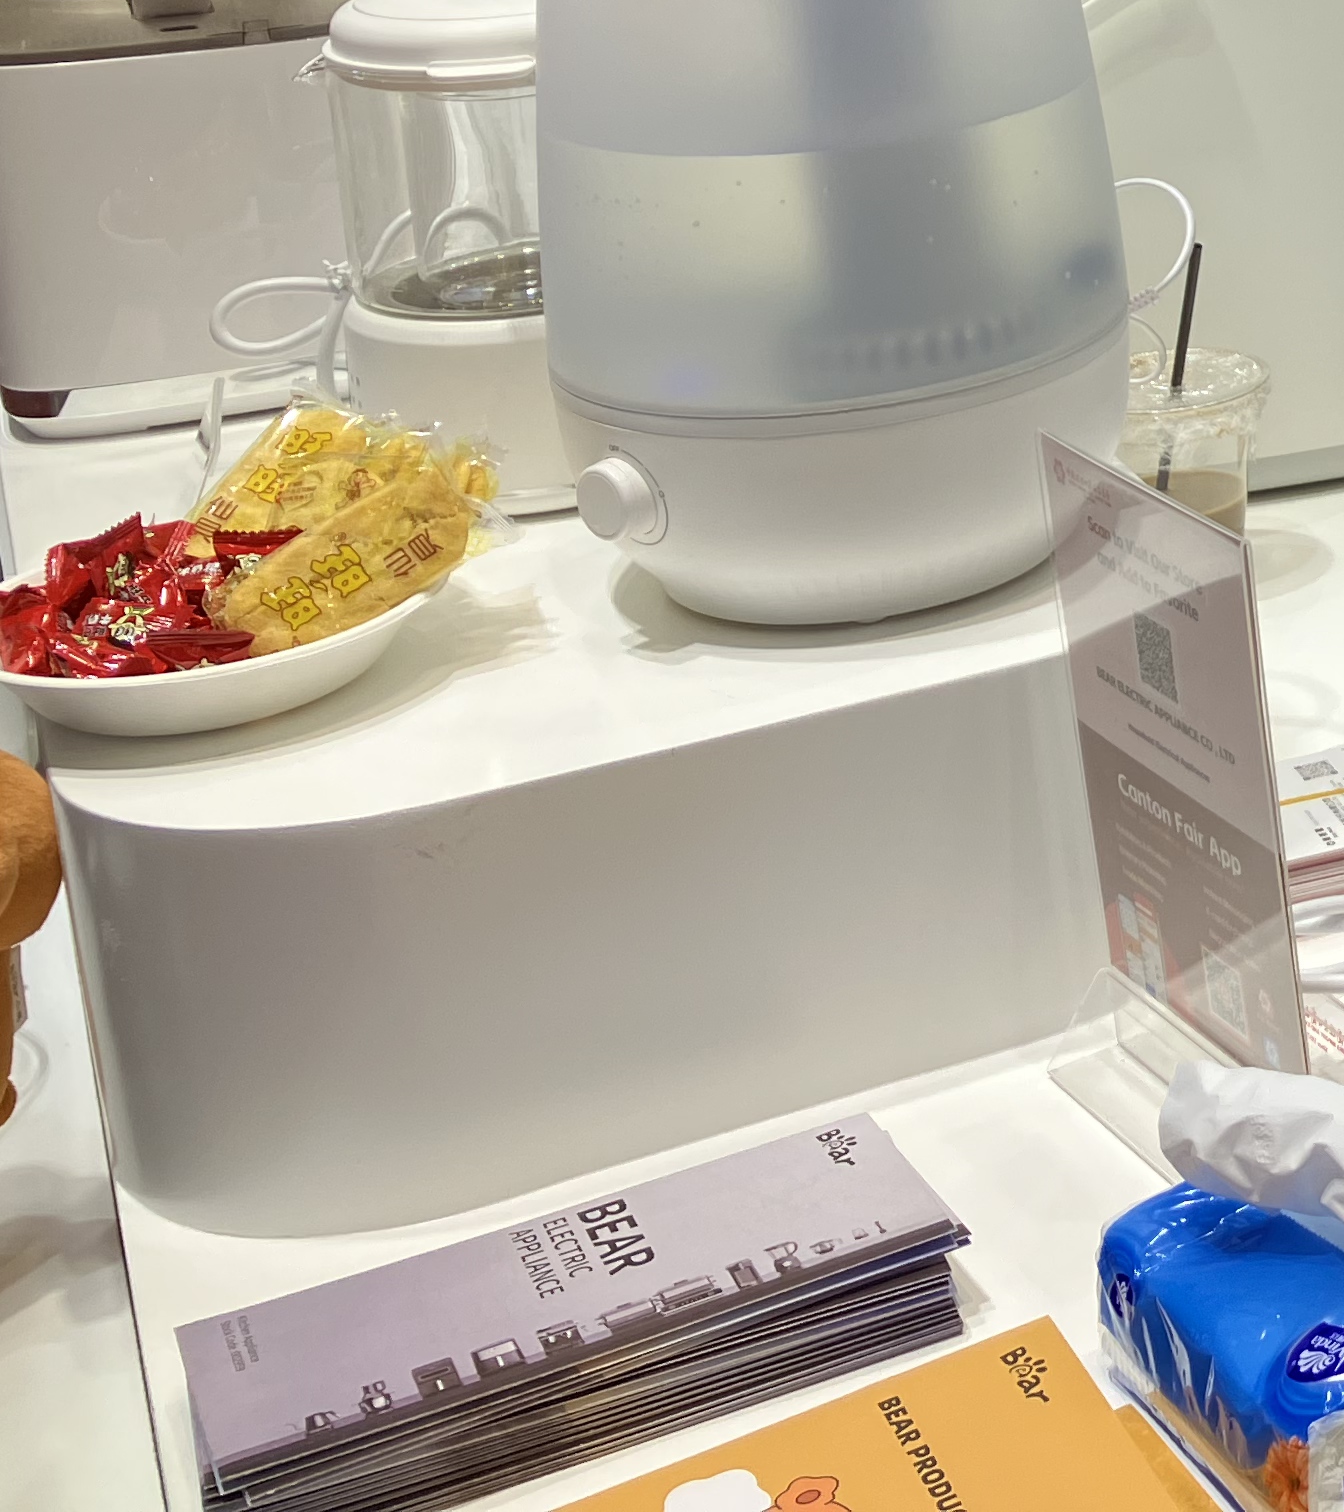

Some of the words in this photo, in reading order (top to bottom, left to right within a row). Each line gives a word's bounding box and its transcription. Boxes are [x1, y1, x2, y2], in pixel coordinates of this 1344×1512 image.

[1087, 516, 1111, 540] Scan
[1112, 531, 1124, 548] to
[1125, 538, 1149, 562] Visit
[1151, 553, 1170, 576] Our
[1172, 565, 1203, 595] Store
[1097, 552, 1116, 571] and
[1153, 584, 1199, 622] Favorite
[1096, 666, 1116, 688] BEAR
[1117, 680, 1153, 712] ELECTRIC
[1154, 704, 1200, 743] APPLIANCE
[1117, 774, 1172, 827] Canton
[1174, 812, 1203, 849] Fair
[1209, 836, 1242, 876] App
[816, 1129, 857, 1165] Bear
[508, 1228, 565, 1299] APPLIANCE
[543, 1217, 593, 1278] ELECTRIC
[577, 1198, 655, 1275] BEAR
[999, 1346, 1050, 1404] Bear
[877, 1395, 921, 1447] BEAR
[906, 1443, 968, 1512] PRODU
